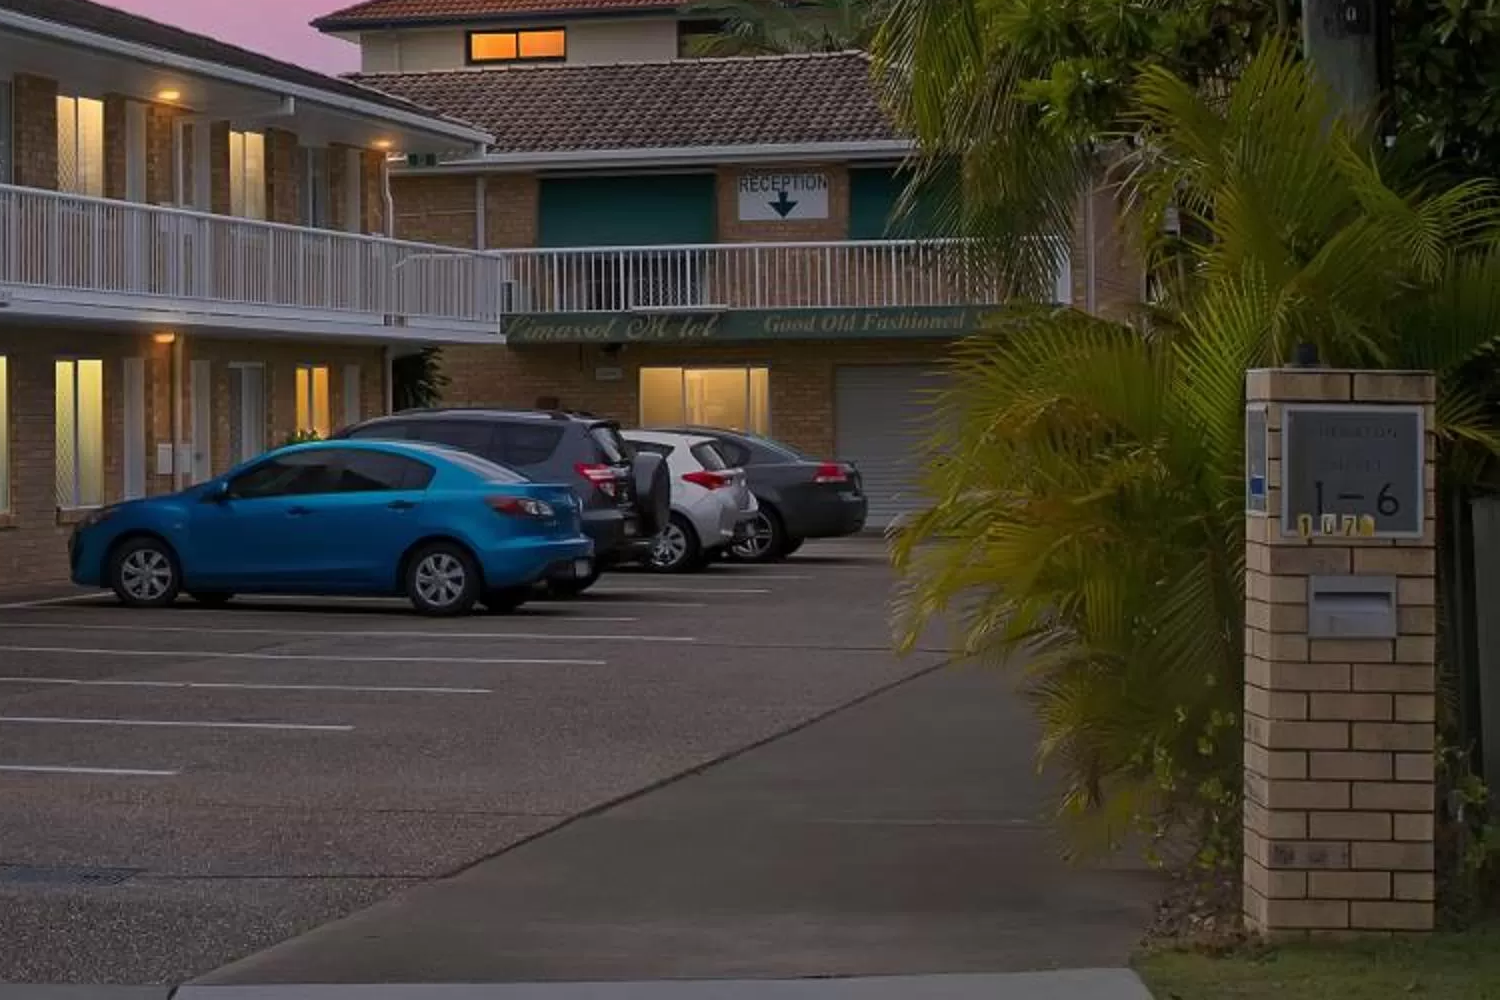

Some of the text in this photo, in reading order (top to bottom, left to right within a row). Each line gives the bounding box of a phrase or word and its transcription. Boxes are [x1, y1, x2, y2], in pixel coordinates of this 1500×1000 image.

[738, 174, 828, 193] RECEPTION
[626, 313, 719, 341] Mtel
[763, 314, 815, 333] Good
[820, 313, 856, 333] Old
[861, 310, 965, 332] Fashioned
